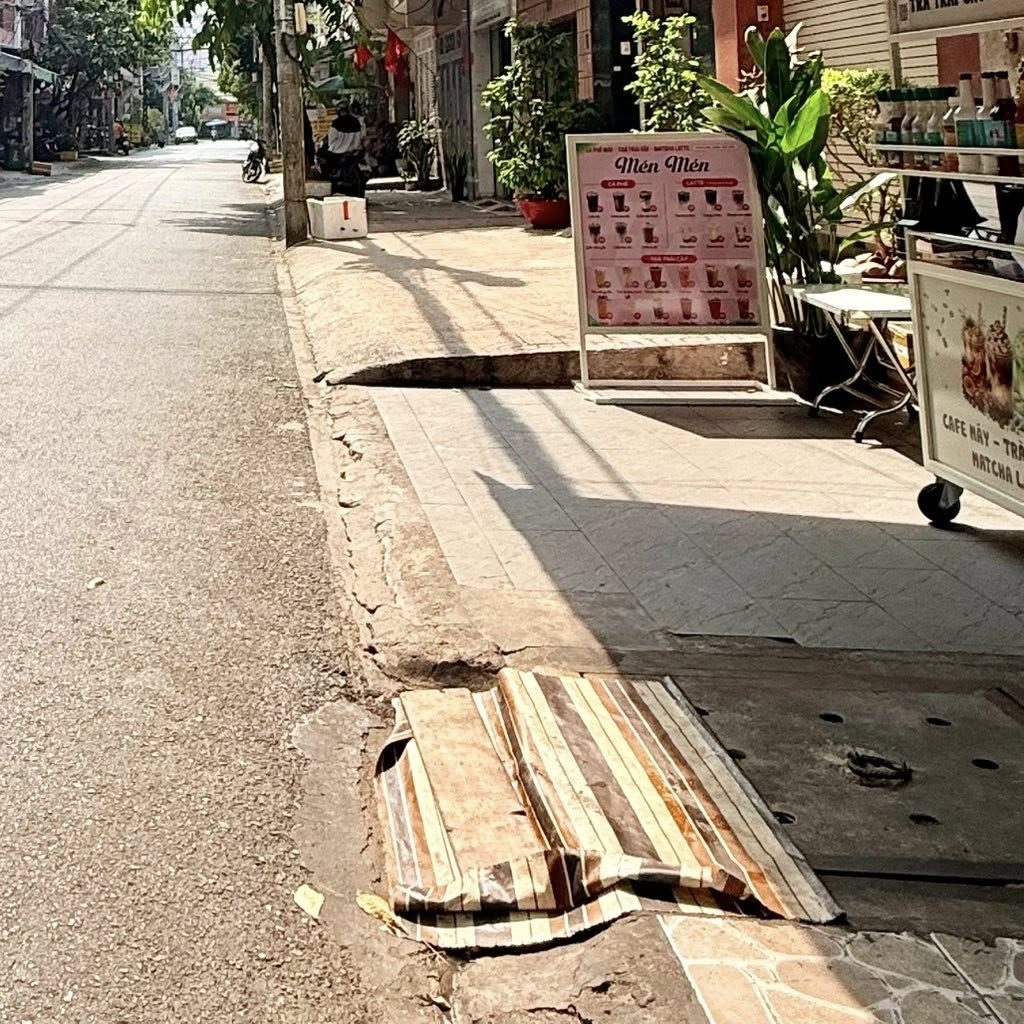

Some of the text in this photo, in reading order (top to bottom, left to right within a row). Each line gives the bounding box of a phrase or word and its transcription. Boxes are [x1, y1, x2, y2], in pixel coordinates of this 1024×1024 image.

[615, 155, 710, 174] Mén Mén
[943, 413, 967, 438] CAFE
